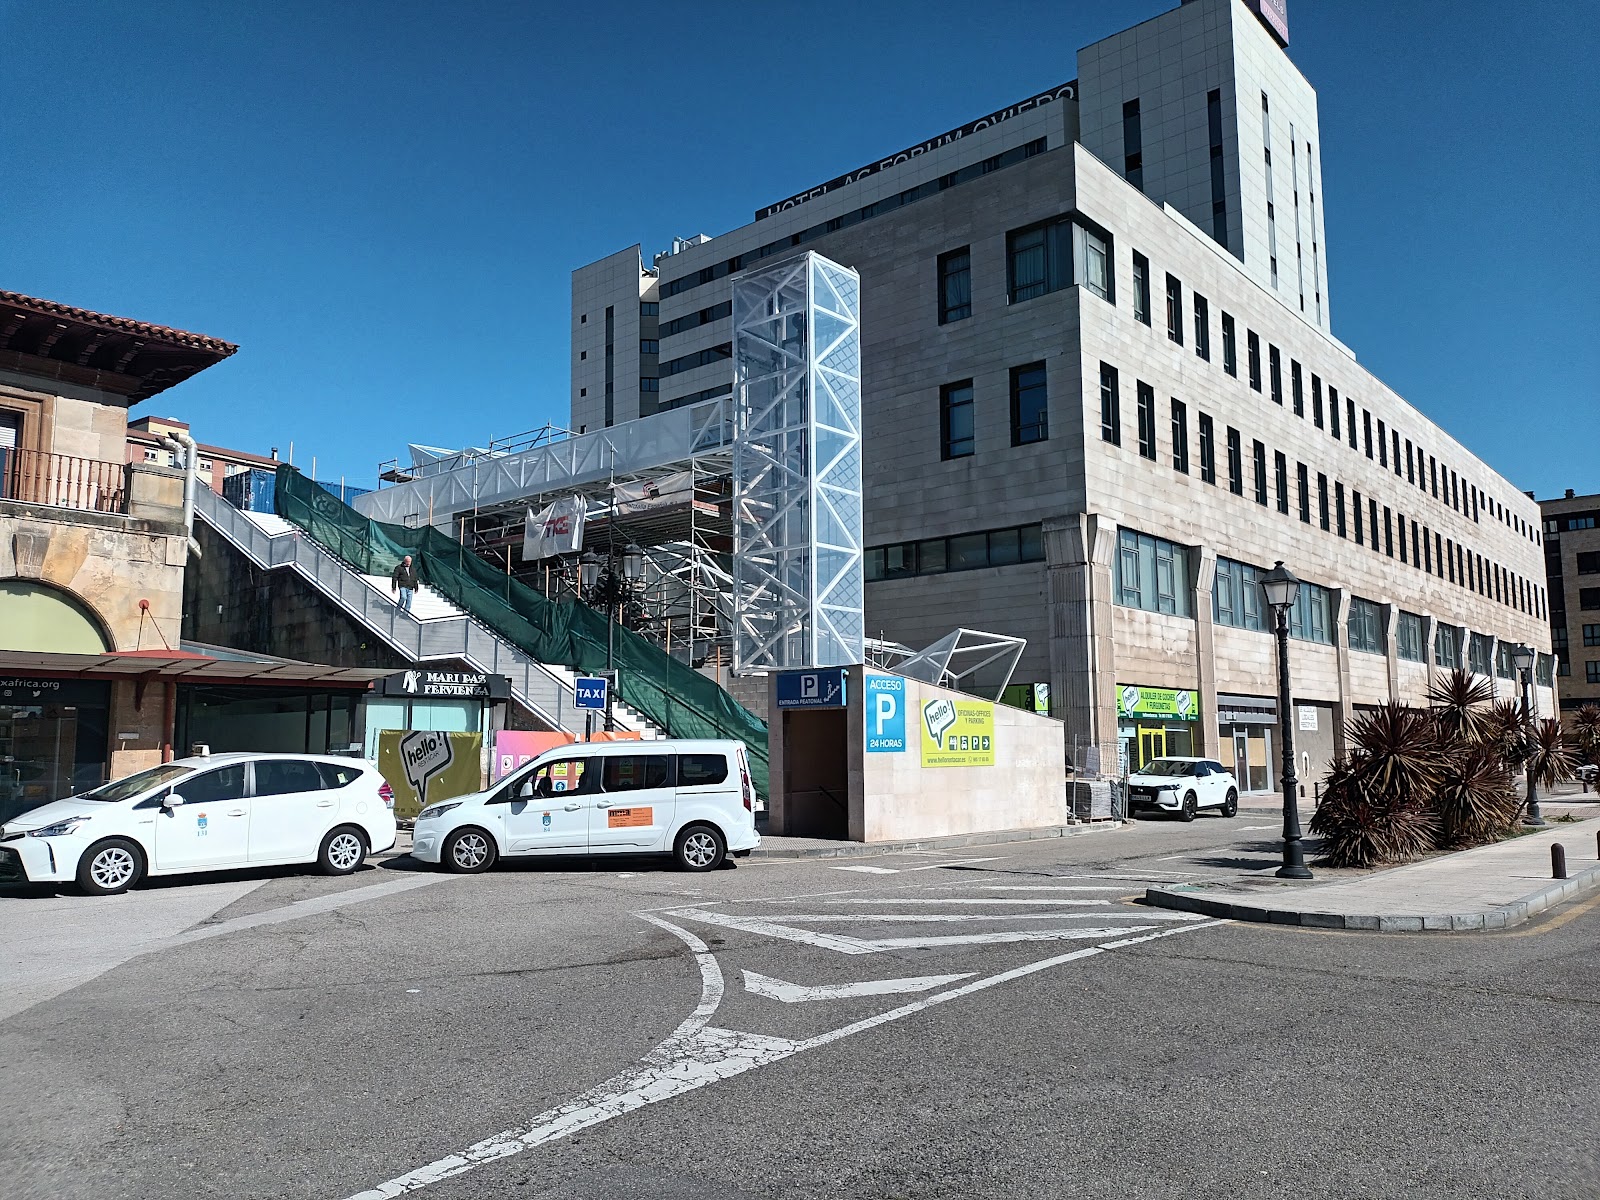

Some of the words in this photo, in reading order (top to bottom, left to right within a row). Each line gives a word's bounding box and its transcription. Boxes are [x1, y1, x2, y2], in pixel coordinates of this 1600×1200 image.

[427, 672, 459, 683] MARI
[424, 684, 490, 696] FERVIENZA
[804, 677, 815, 695] P
[870, 679, 901, 690] ACCESO
[577, 689, 605, 698] TAXI
[876, 693, 897, 735] P
[929, 700, 950, 724] hello!
[408, 731, 442, 767] hello!
[870, 739, 879, 748] 24
[880, 738, 902, 748] HORAS
